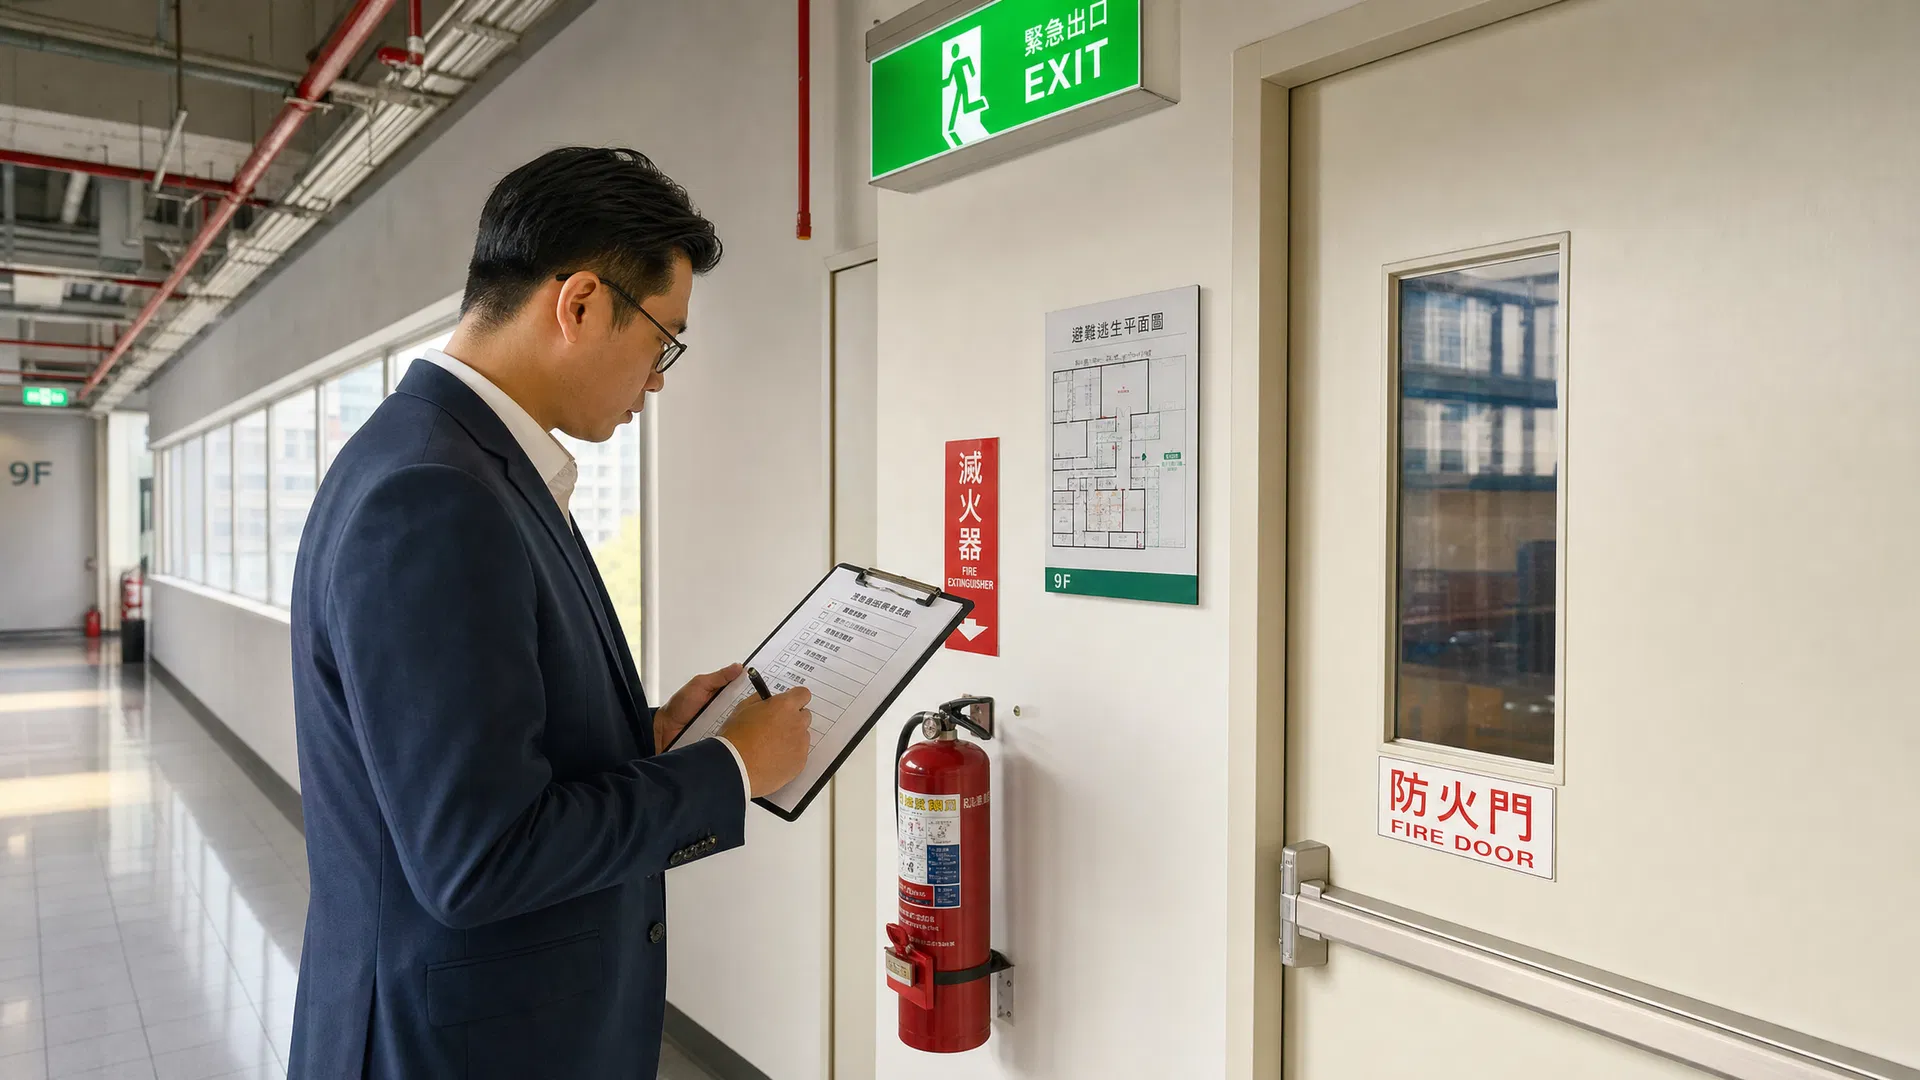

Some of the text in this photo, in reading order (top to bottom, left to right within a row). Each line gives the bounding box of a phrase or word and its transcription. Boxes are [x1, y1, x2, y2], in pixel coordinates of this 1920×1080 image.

[1025, 0, 1107, 57] 緊急出口
[1025, 37, 1109, 104] EXIT
[1072, 312, 1164, 343] 避難逃生平面圖
[9, 461, 52, 486] 9F
[958, 450, 983, 561] 滅火器
[947, 577, 994, 590] EXTINGUISHER
[962, 566, 977, 577] FIRE
[1054, 573, 1071, 589] 9F
[1390, 768, 1532, 843] 防火門
[1391, 819, 1534, 869] FIRE DOOR
